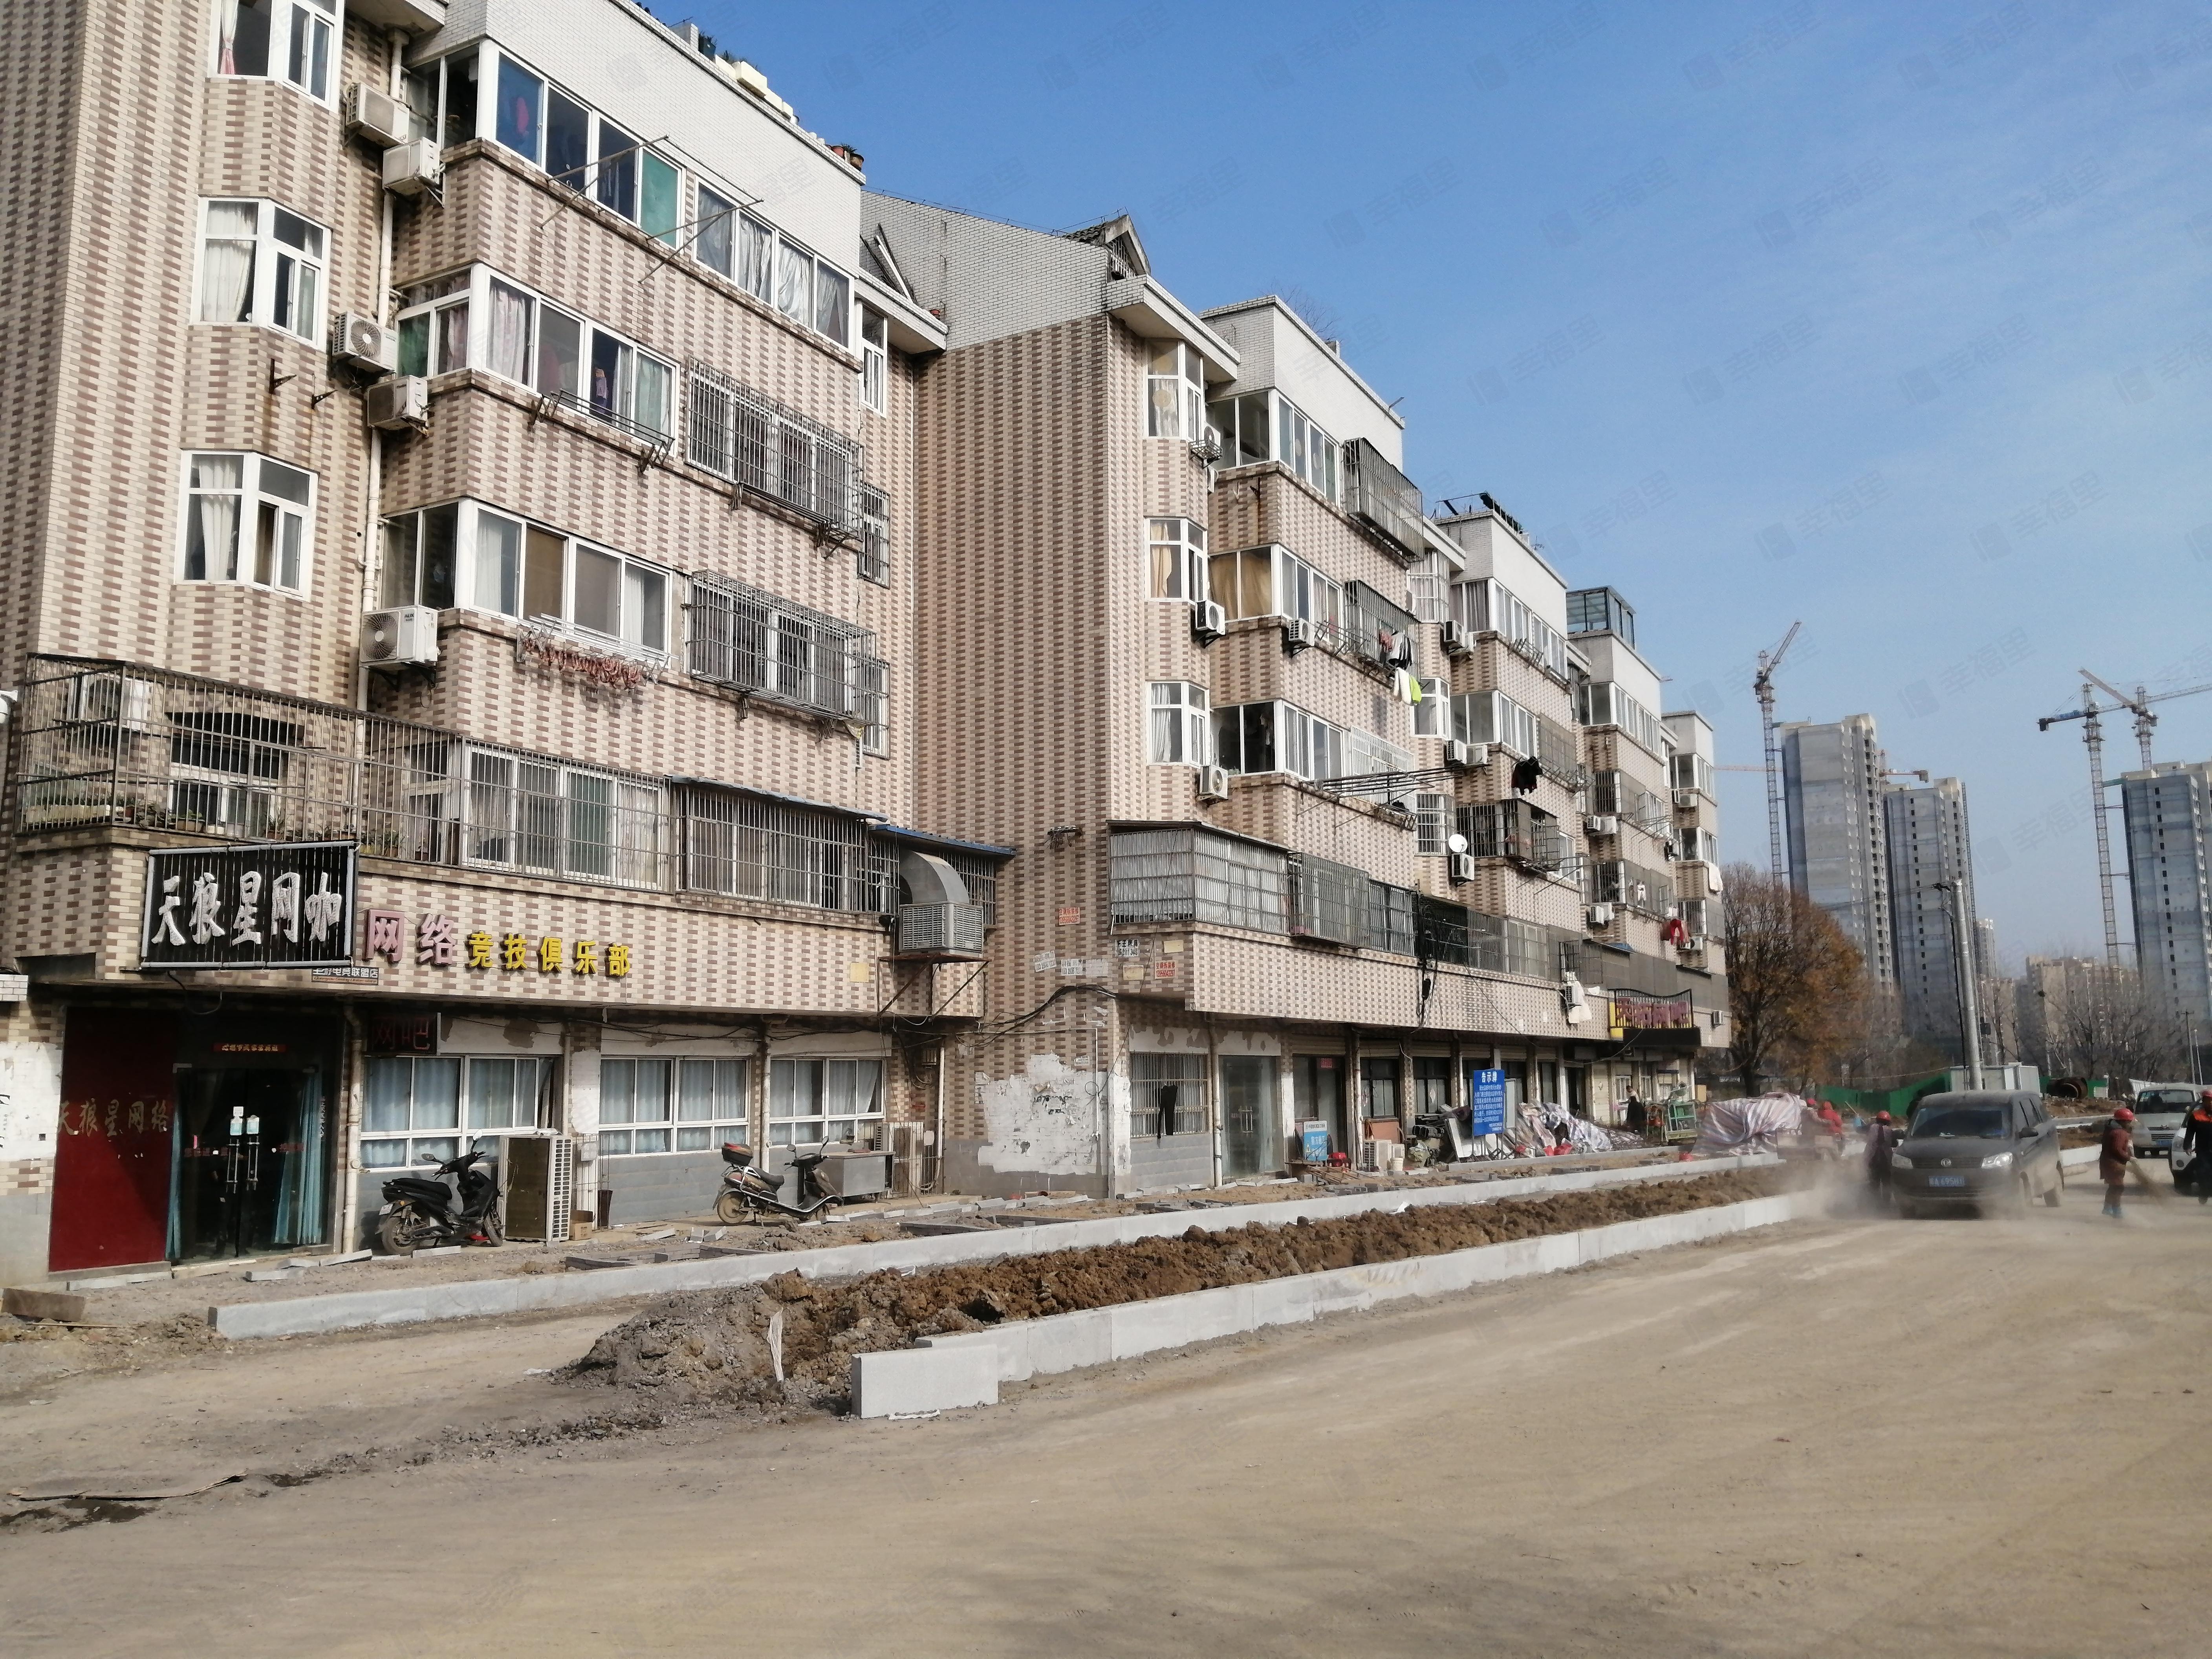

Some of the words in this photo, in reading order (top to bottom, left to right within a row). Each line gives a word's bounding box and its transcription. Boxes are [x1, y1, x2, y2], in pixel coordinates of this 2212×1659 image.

[151, 871, 342, 947] 天狼星网咖
[363, 908, 457, 966] 网络
[467, 930, 631, 978] 竞技俱乐部
